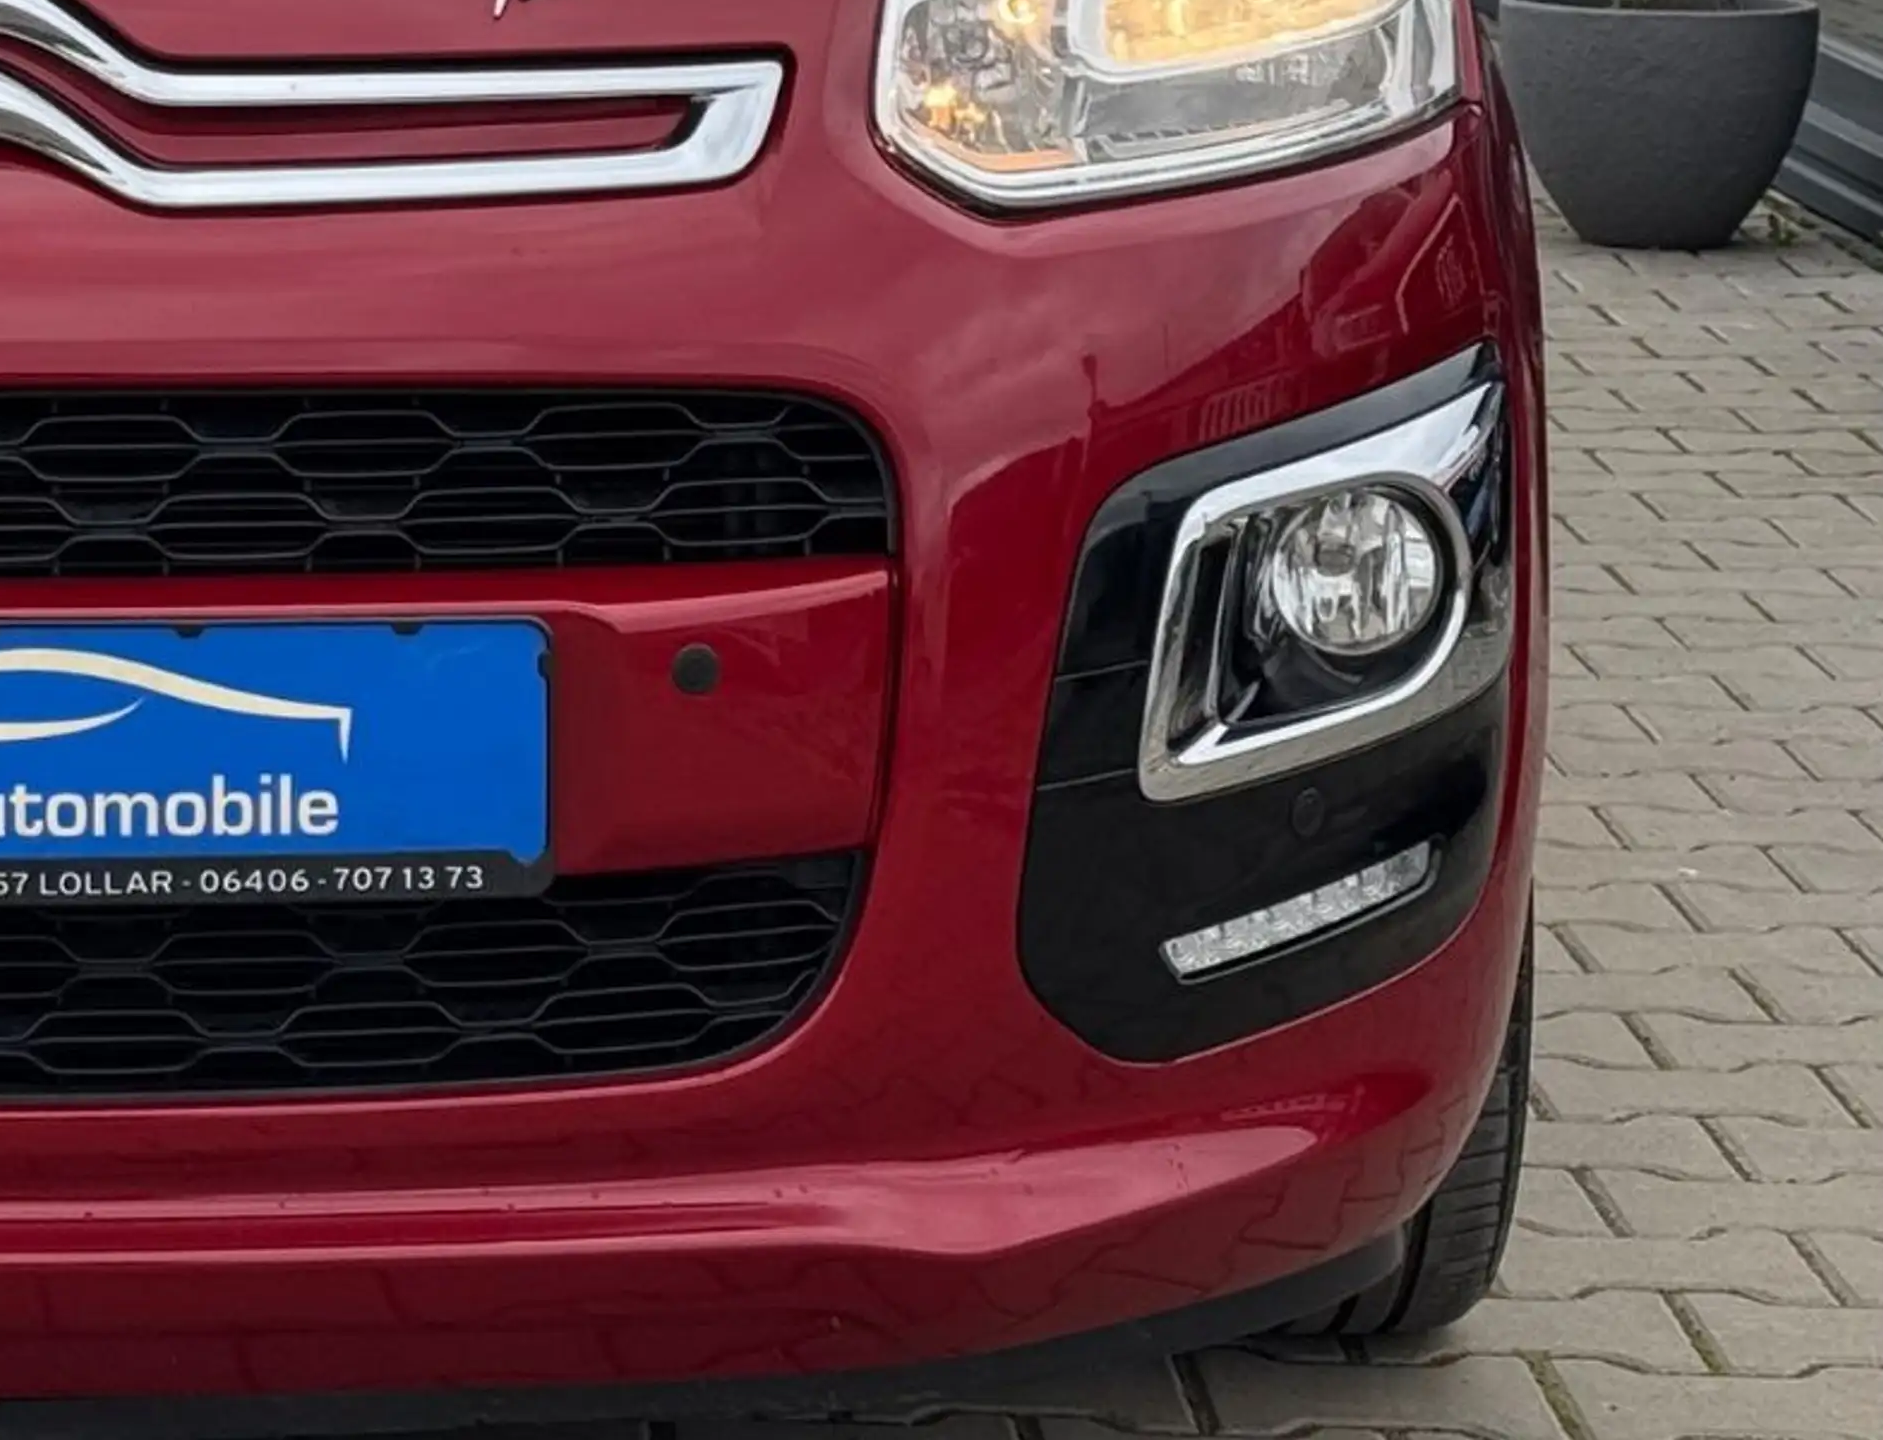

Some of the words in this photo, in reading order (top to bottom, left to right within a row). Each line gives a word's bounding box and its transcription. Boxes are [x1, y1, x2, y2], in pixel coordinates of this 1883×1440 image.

[38, 870, 174, 897] LOLLAR
[198, 868, 311, 895] 06406
[332, 865, 394, 892] 707
[401, 865, 436, 891] 13
[444, 864, 484, 890] 73
